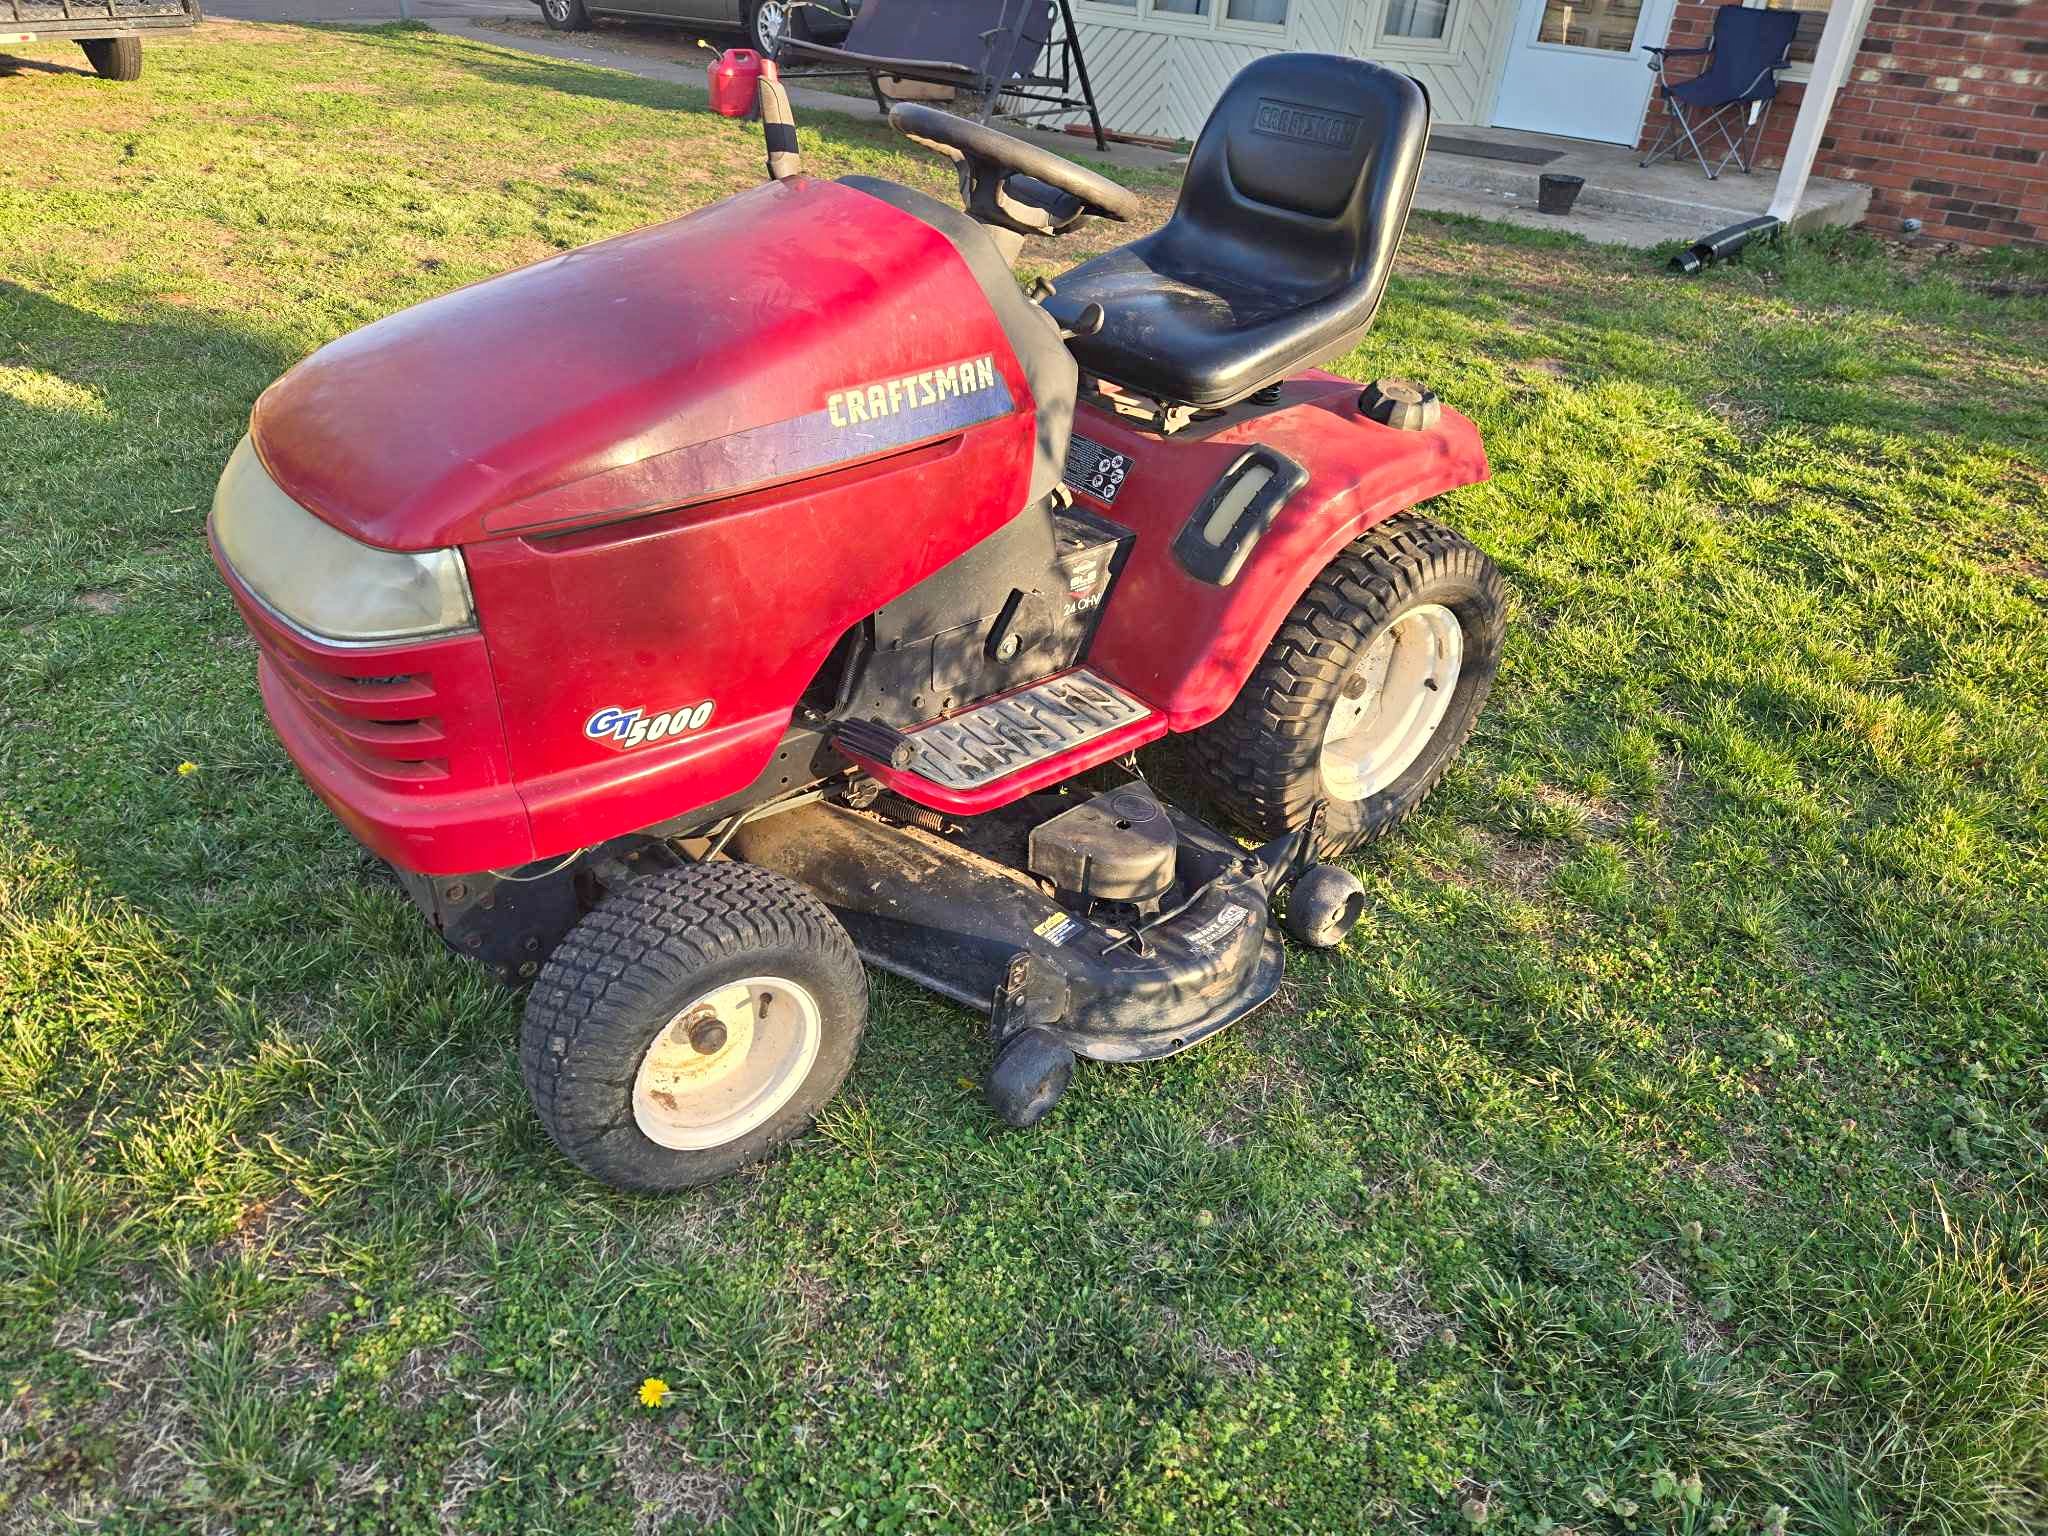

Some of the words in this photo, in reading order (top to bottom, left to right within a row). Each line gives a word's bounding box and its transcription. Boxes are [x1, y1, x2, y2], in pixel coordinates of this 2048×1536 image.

[827, 356, 994, 428] CRAFTSMAN
[1063, 601, 1077, 617] 24
[586, 707, 644, 741] GT
[623, 700, 714, 748] 5000
